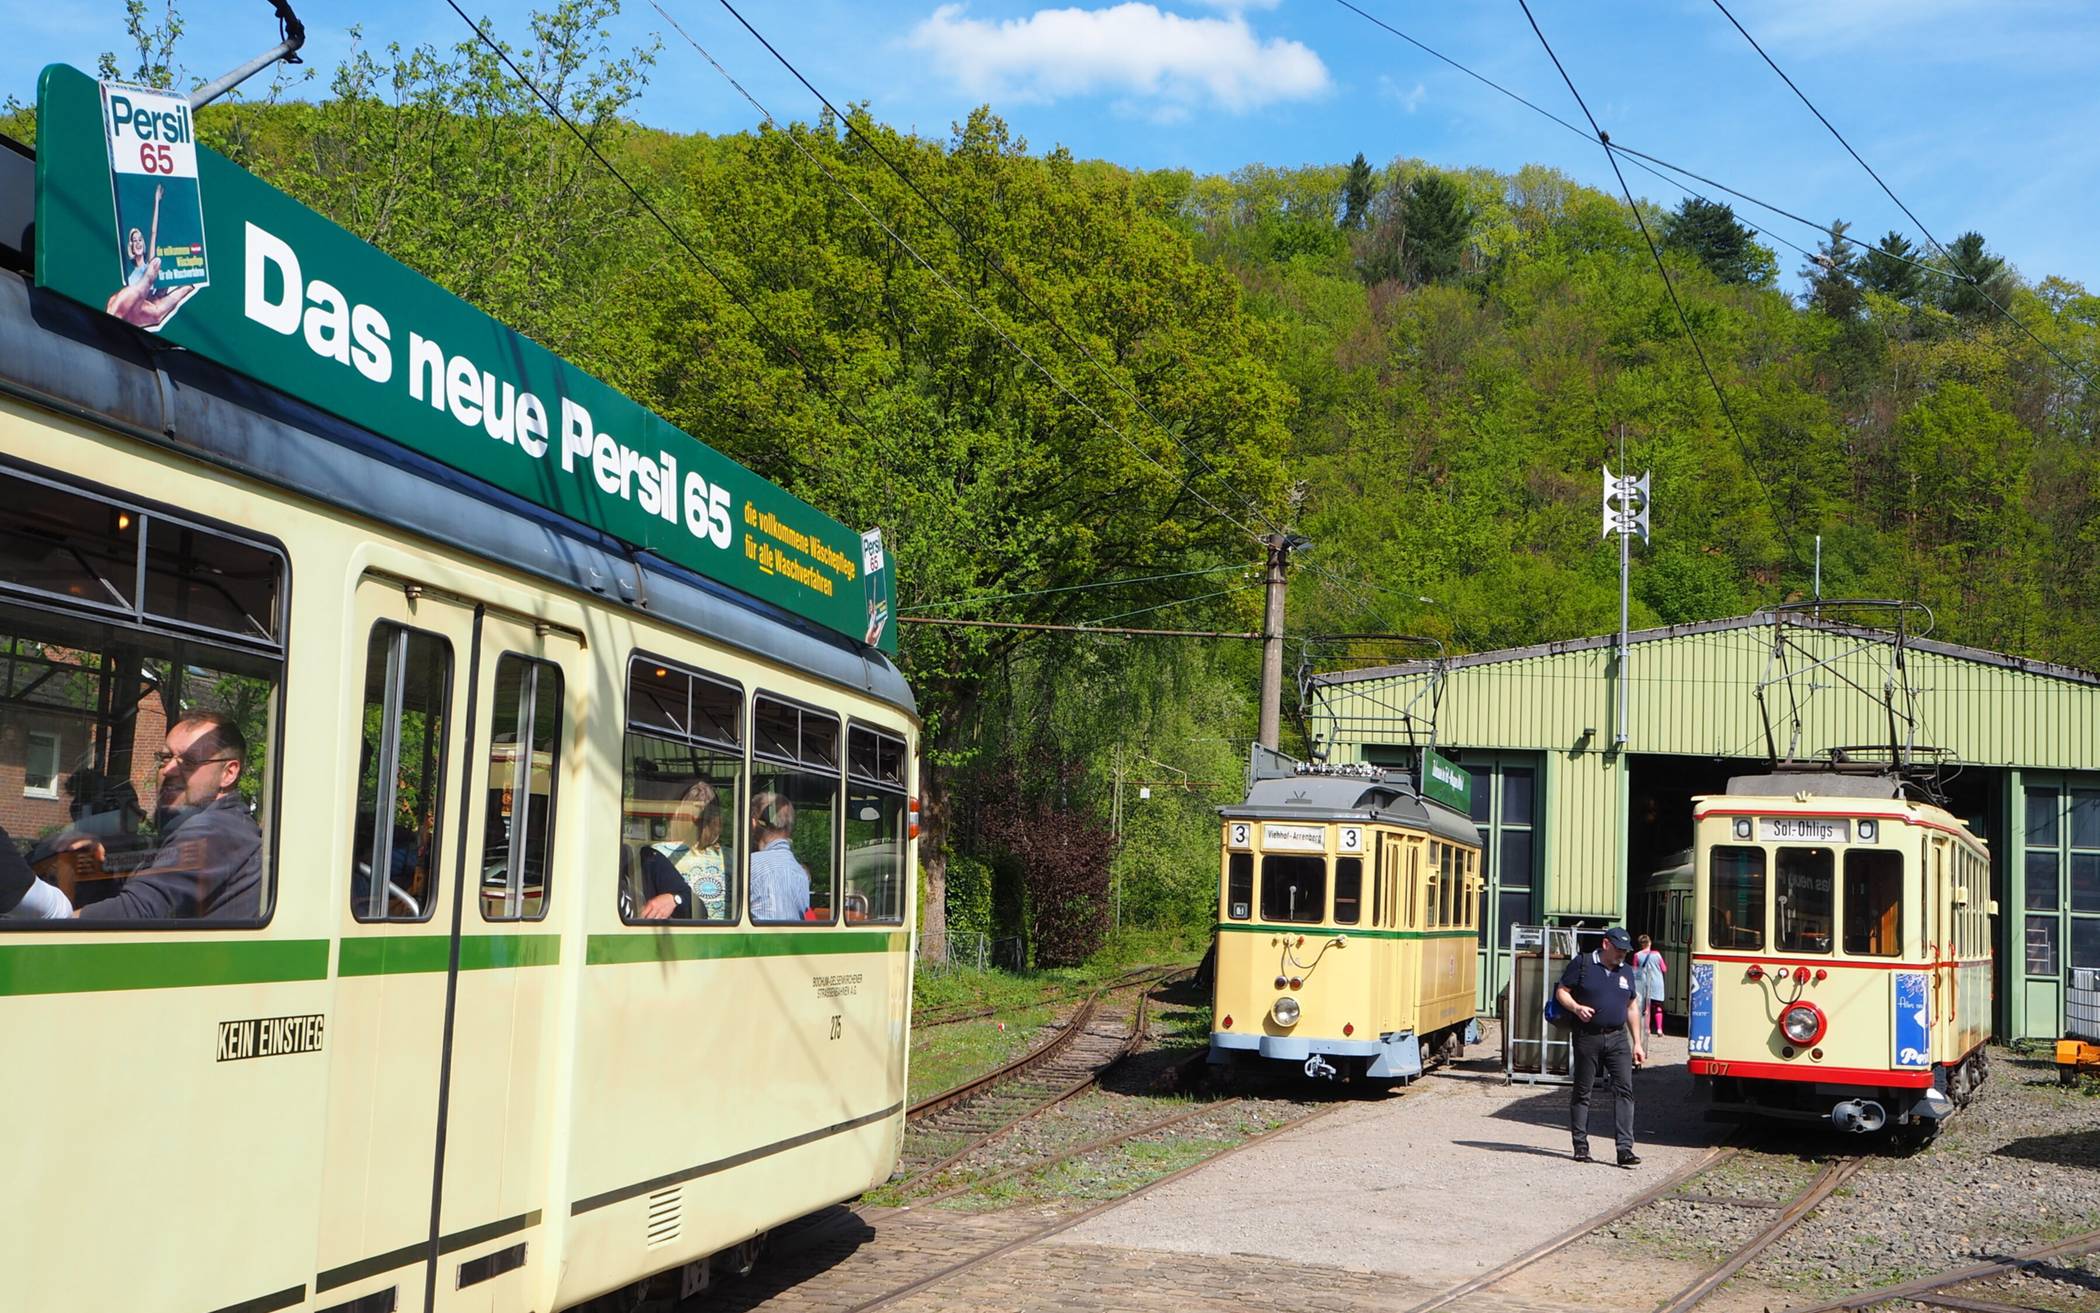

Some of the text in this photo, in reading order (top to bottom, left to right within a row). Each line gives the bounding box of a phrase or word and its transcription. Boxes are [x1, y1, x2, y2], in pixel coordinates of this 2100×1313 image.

[110, 95, 190, 144] Persil
[140, 143, 174, 175] 65
[244, 220, 732, 550] Das neue Persil 65
[744, 501, 856, 581] die vollkommene Wäschepflege
[744, 534, 833, 597] für alle Waschverfahren
[870, 555, 878, 571] 65
[1235, 825, 1246, 843] 3
[1345, 829, 1357, 848] 3
[218, 1016, 324, 1060] KEIN EINSTIEG
[830, 1015, 842, 1040] 275
[1705, 1061, 1728, 1075] 107
